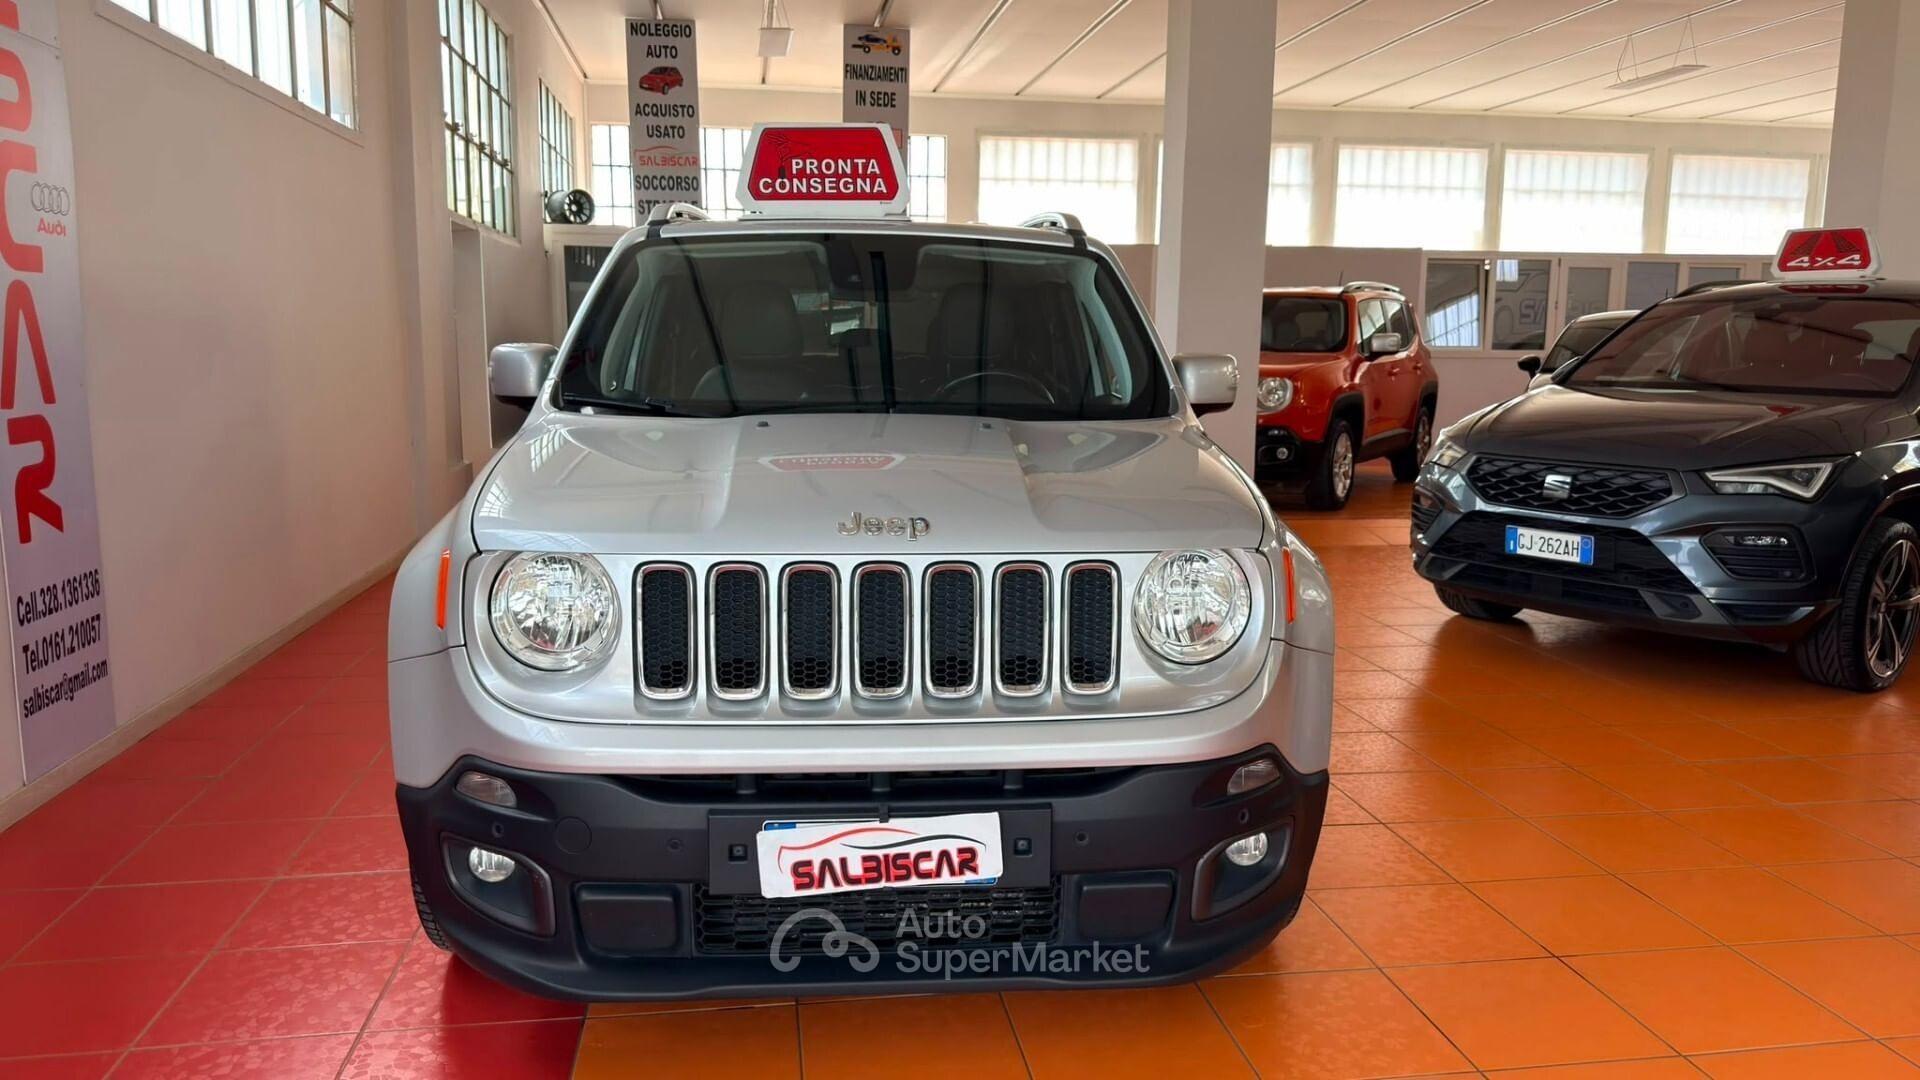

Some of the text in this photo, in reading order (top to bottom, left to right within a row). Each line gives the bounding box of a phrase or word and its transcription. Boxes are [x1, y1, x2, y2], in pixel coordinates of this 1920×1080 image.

[630, 22, 692, 38] NOLEGGIO
[646, 45, 678, 59] AUTO
[844, 64, 908, 83] FINANZIAMENTI
[855, 90, 896, 108] IN SEDE
[635, 103, 696, 118] ACQUISTO
[646, 124, 686, 139] USATO
[639, 154, 699, 168] SALBISCAR
[791, 158, 881, 175] PRONTA
[635, 174, 700, 192] SOCCORSO
[758, 177, 888, 194] CONSEGNA
[36, 217, 67, 237] Audi
[837, 511, 931, 542] Jeep
[23, 658, 109, 719] salbiscar@gmail.com
[790, 846, 979, 891] SALBISCAR
